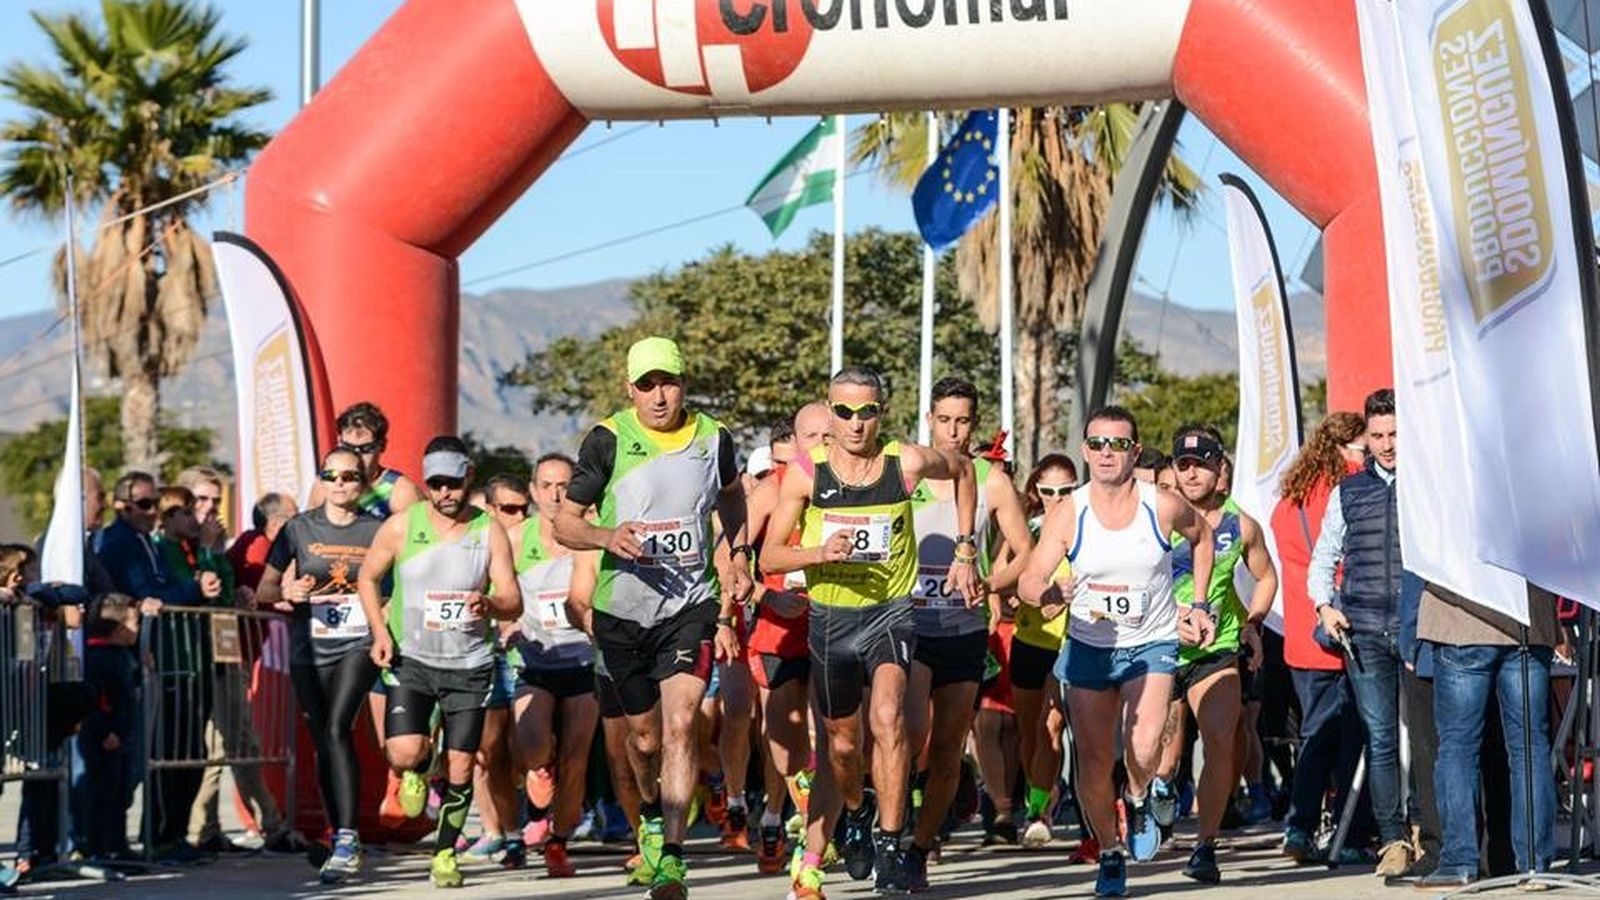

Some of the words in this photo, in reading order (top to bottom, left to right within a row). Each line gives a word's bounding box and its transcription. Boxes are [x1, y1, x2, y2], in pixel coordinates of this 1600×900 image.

[648, 531, 692, 555] 130
[925, 579, 952, 598] 20
[440, 602, 465, 620] 57
[1103, 596, 1130, 615] 19
[327, 606, 352, 625] 87
